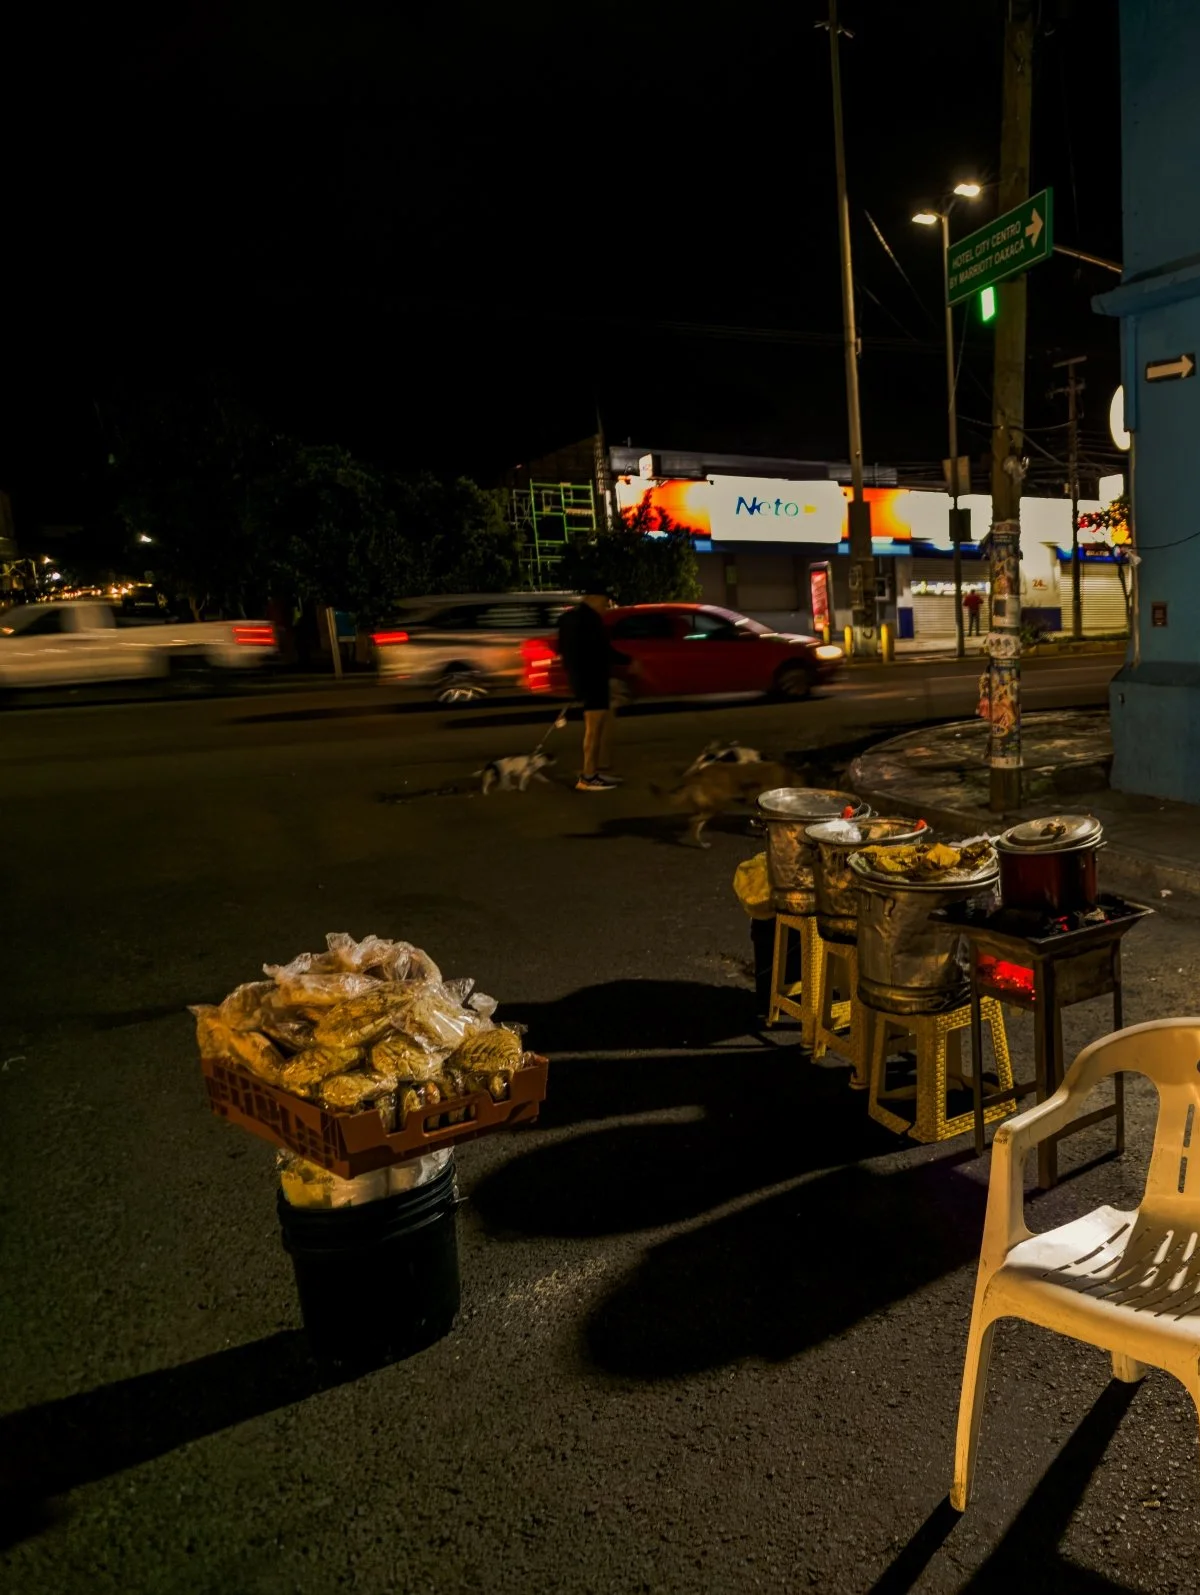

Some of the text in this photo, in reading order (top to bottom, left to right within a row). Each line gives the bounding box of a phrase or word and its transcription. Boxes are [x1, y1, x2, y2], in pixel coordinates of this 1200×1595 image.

[949, 238, 1025, 290] BY MARRIOTT OAXACA
[952, 220, 1021, 269] HOTEL CITY CENTRO
